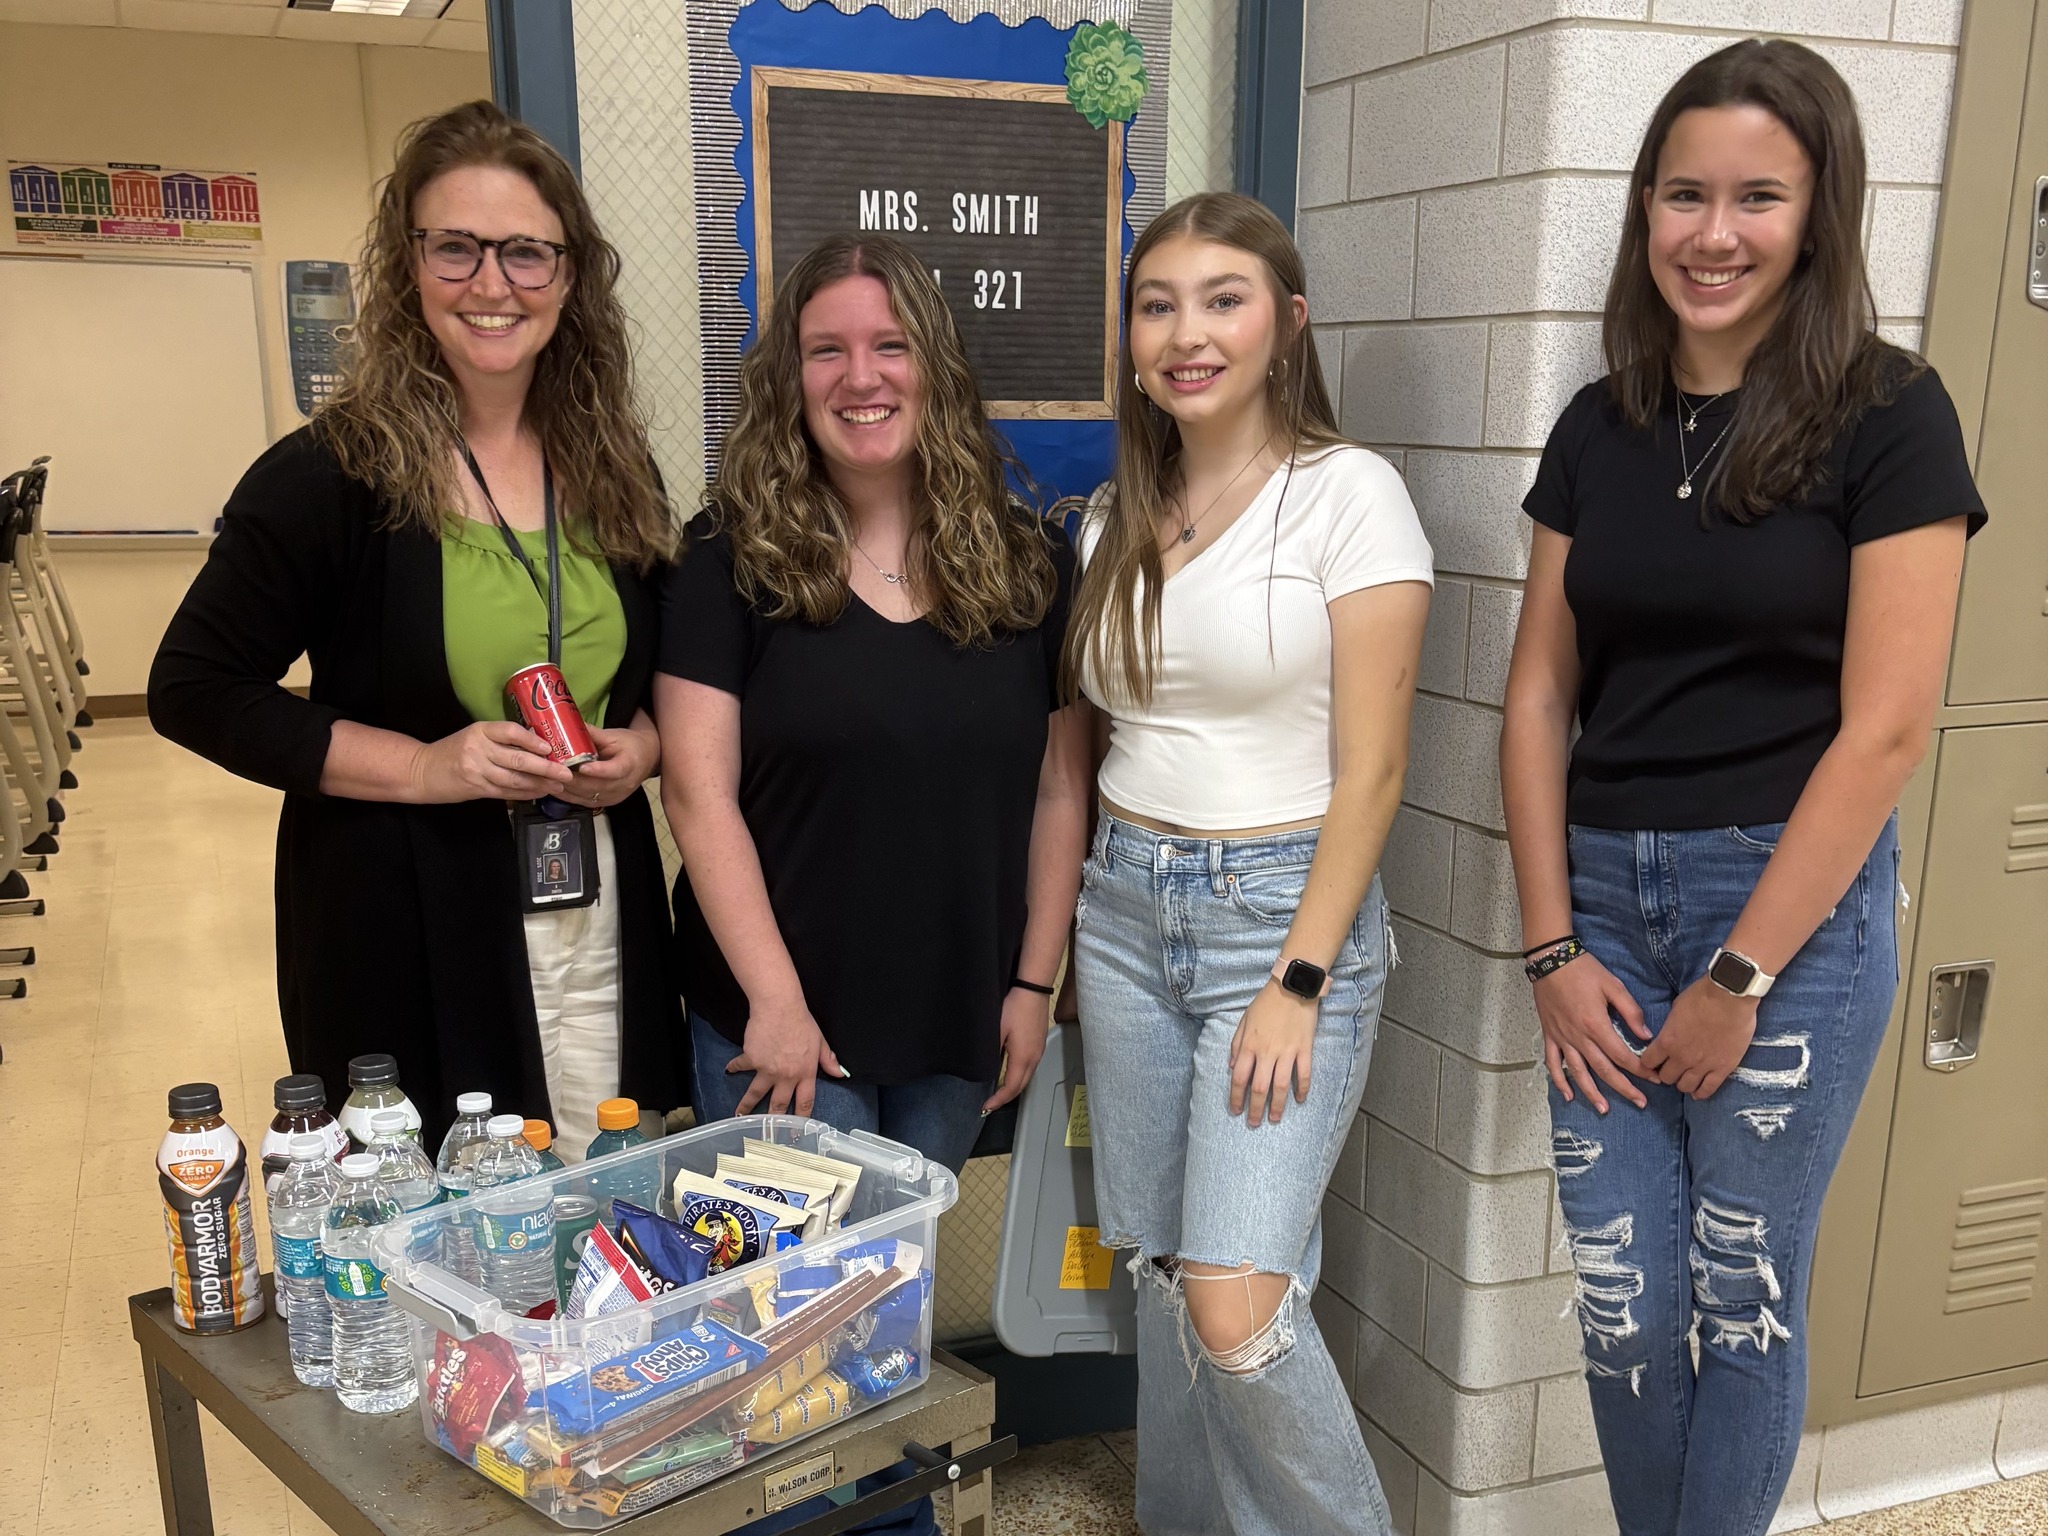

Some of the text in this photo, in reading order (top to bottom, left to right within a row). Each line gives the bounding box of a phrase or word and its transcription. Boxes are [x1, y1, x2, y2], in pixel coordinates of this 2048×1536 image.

[168, 210, 175, 218] 2
[184, 211, 192, 219] 4
[200, 212, 208, 220] 9
[860, 190, 1039, 235] MRS. SMITH
[974, 269, 1022, 310] 321
[176, 1147, 215, 1158] Orange
[178, 1165, 215, 1176] ZERO
[183, 1174, 212, 1182] SUGAR
[212, 1196, 228, 1259] ZERO SUGAR
[684, 1199, 758, 1245] PIRATE'S BOOTY
[191, 1198, 223, 1316] BODYARMOR
[654, 1345, 709, 1377] Chips
[433, 1348, 467, 1420] Skittles
[614, 1383, 653, 1401] ORIGINAL
[797, 1396, 809, 1424] Hostess
[824, 1386, 836, 1414] Hostess
[772, 1408, 782, 1434] ostess
[810, 1466, 832, 1482] CORP.
